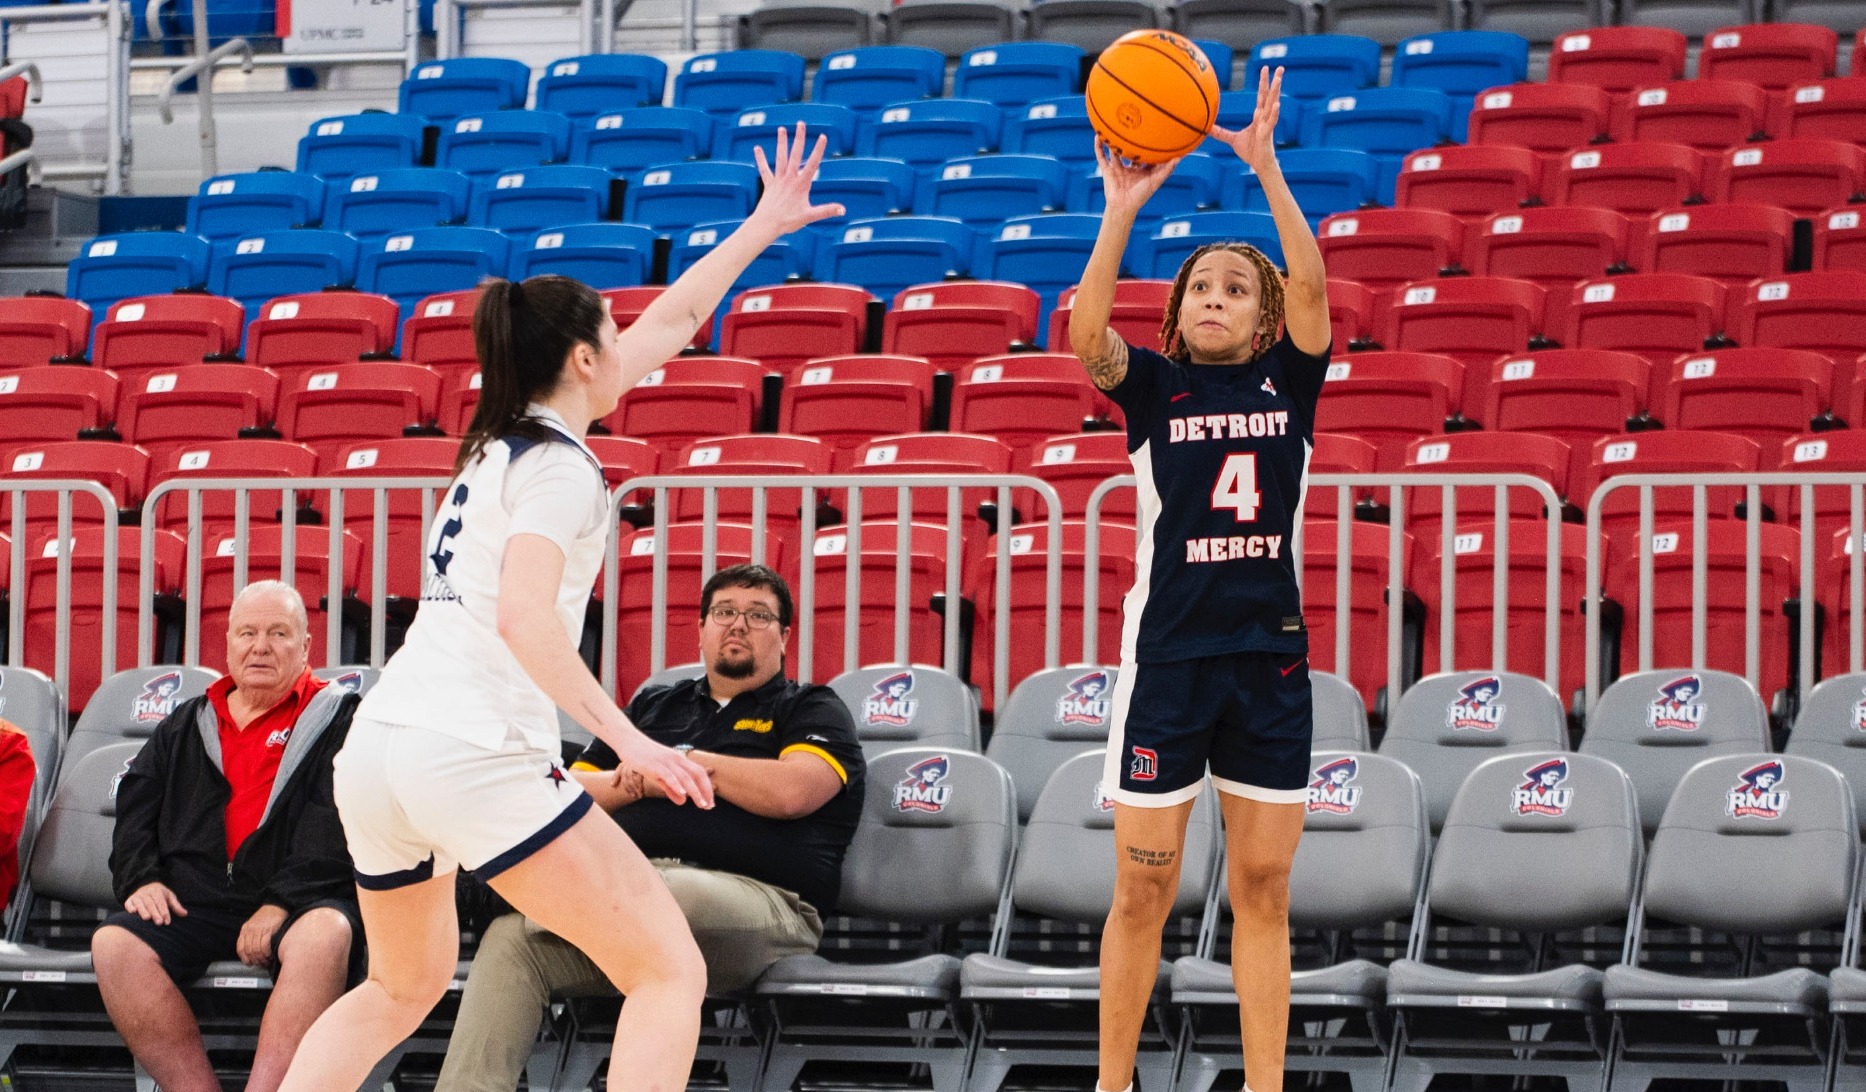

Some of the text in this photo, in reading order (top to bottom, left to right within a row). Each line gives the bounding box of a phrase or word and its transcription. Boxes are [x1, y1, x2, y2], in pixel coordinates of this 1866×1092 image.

[1594, 288, 1606, 300] 11
[1512, 363, 1527, 376] 11
[1694, 362, 1708, 375] 12
[1168, 410, 1289, 444] DETROIT
[1427, 447, 1441, 460] 11
[1614, 446, 1629, 459] 12
[1803, 445, 1819, 458] 13
[1210, 451, 1263, 524] 4
[429, 483, 469, 576] 2
[1185, 534, 1283, 564] MERCY
[1459, 538, 1473, 552] 11
[1655, 537, 1670, 551] 12
[863, 700, 917, 720] RMU
[1057, 700, 1110, 720] RMU
[1448, 704, 1505, 725] RMU
[1648, 704, 1705, 725] RMU
[893, 785, 951, 805] RMU
[1306, 787, 1361, 807] RMU
[1512, 788, 1571, 810] RMU
[1726, 791, 1787, 812] RMU
